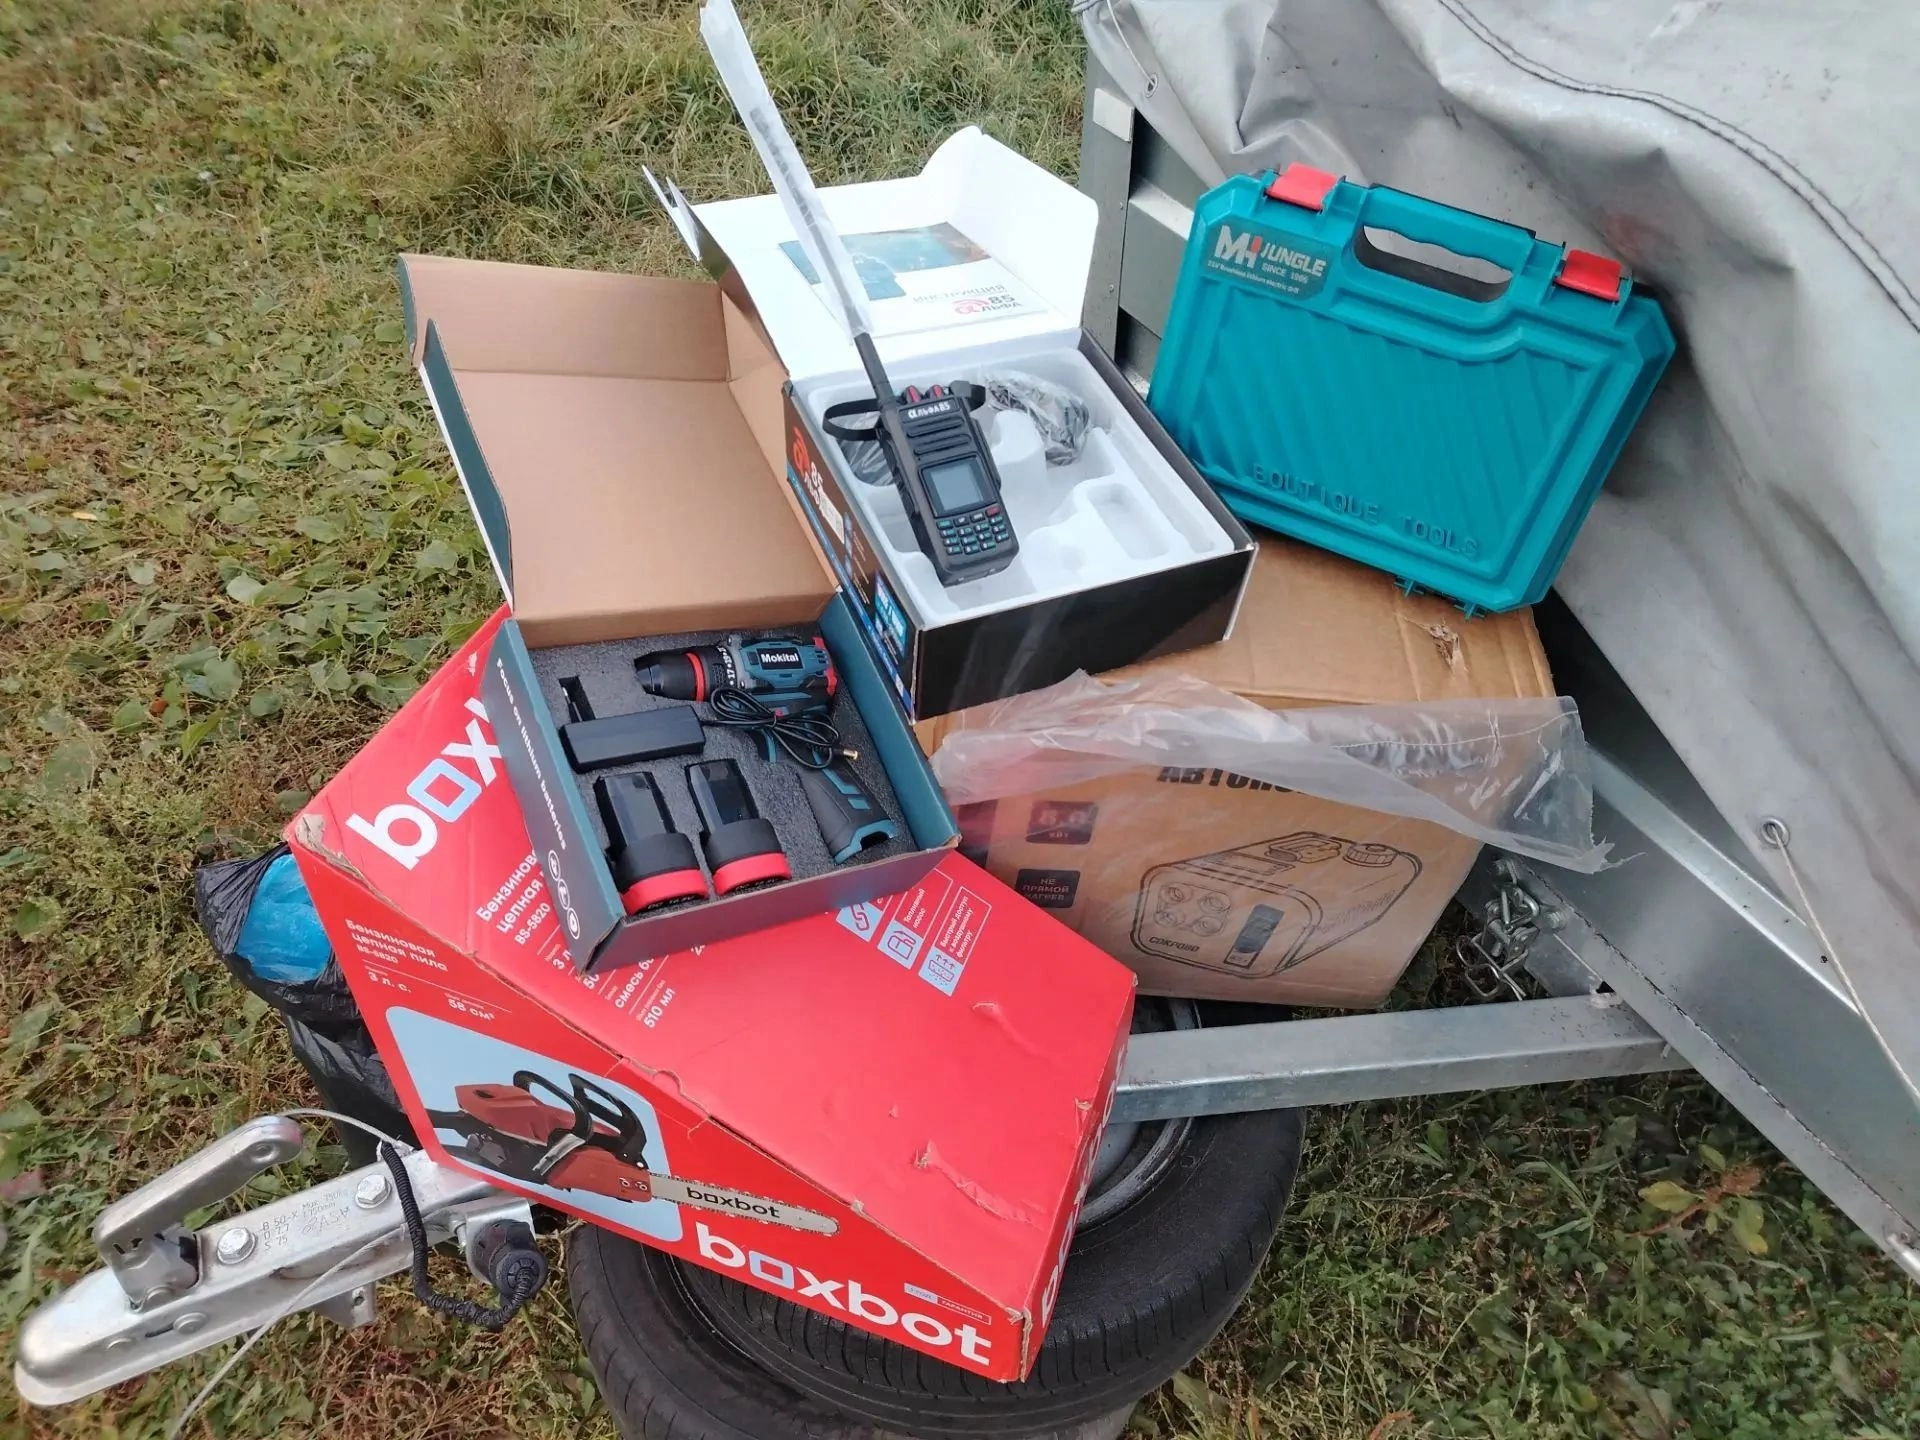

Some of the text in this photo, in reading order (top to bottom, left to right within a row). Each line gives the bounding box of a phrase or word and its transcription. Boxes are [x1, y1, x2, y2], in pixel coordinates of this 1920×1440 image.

[1260, 242, 1327, 277] JUNGLE
[1253, 464, 1480, 560] BOUTIQUE TOOLS
[760, 651, 799, 664] Mokital
[497, 658, 567, 850] Focus on lithium batteries
[496, 878, 544, 934] цепная
[1022, 884, 1070, 894] ПРЯМОЙ
[345, 918, 436, 958] Бензиновая
[514, 903, 551, 945] BS-5820
[351, 933, 407, 958] цепная
[410, 952, 448, 972] пила
[553, 958, 565, 970] 3
[367, 971, 378, 982] 3
[614, 970, 645, 1008] смесь
[448, 998, 467, 1012] 58
[643, 1004, 663, 1029] 510
[660, 987, 676, 1007] мл
[686, 1185, 781, 1219] boxbot
[695, 1221, 992, 1366] boxbot
